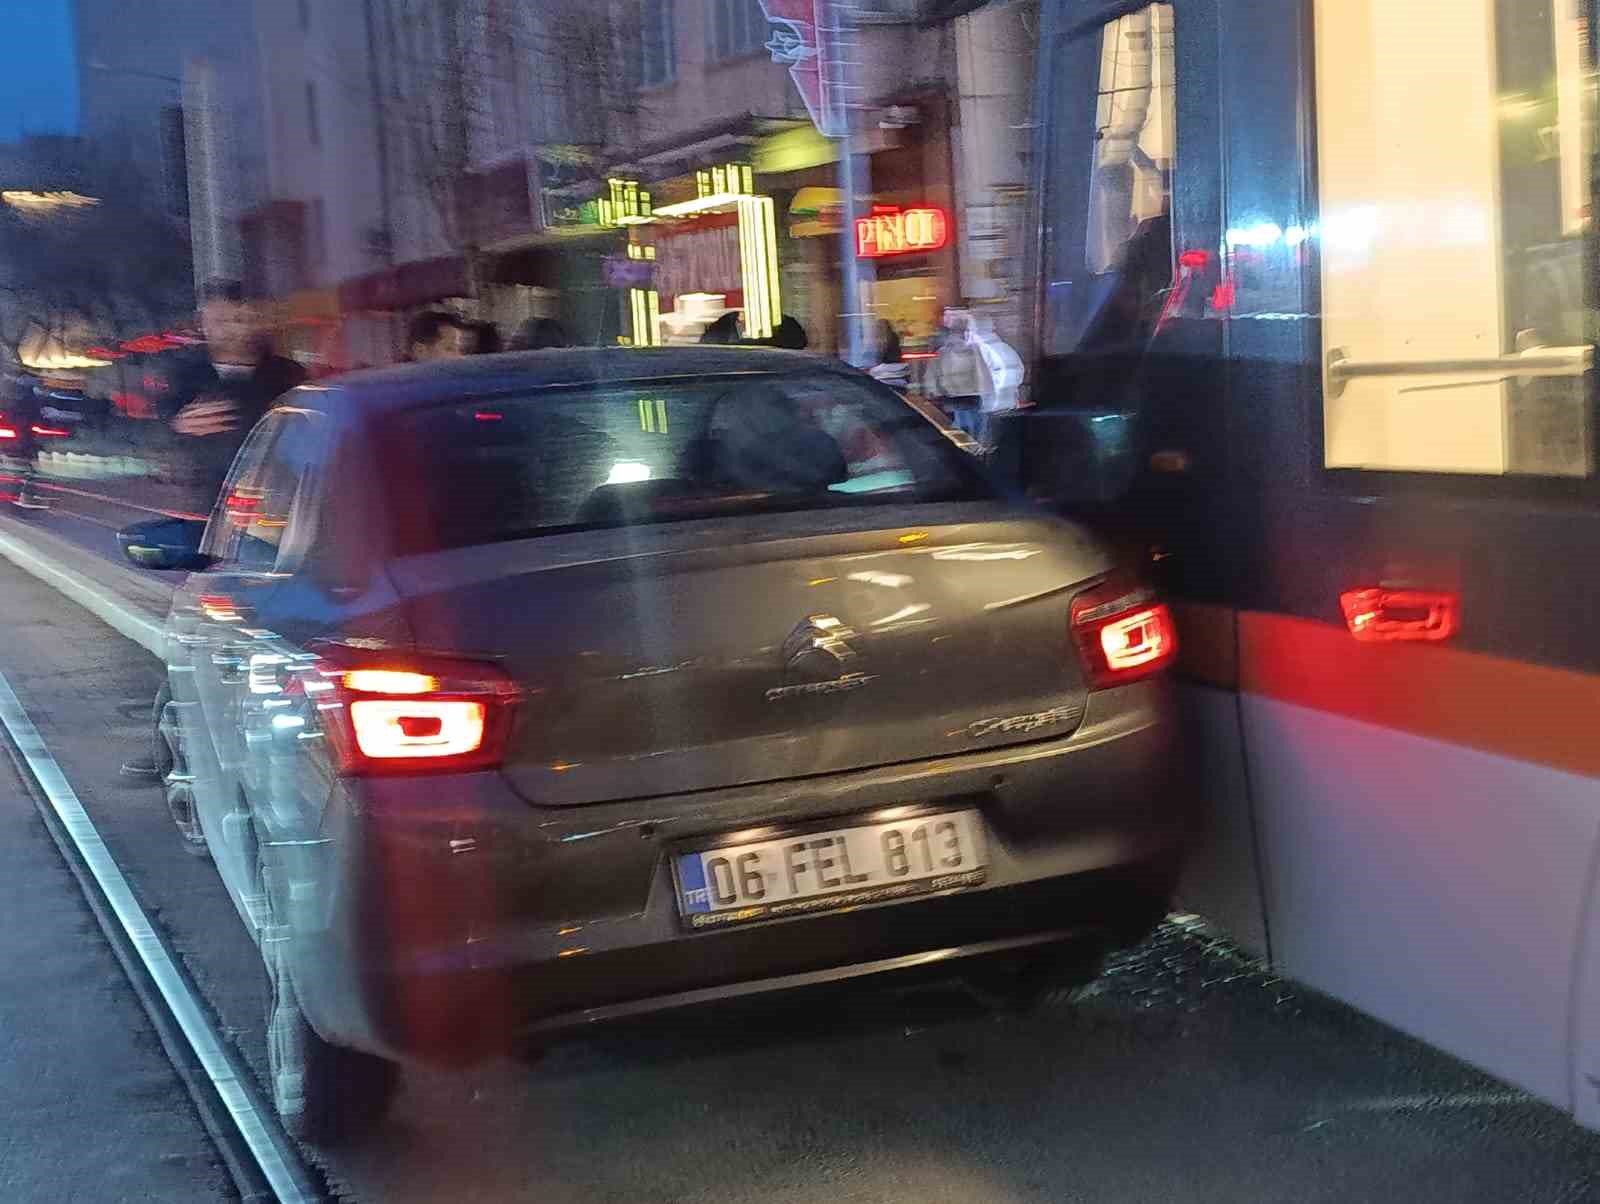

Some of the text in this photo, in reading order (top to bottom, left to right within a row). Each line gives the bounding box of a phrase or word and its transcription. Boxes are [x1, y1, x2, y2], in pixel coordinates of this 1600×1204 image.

[706, 852, 767, 905] 06
[783, 835, 870, 894] FEL
[881, 820, 963, 877] 813
